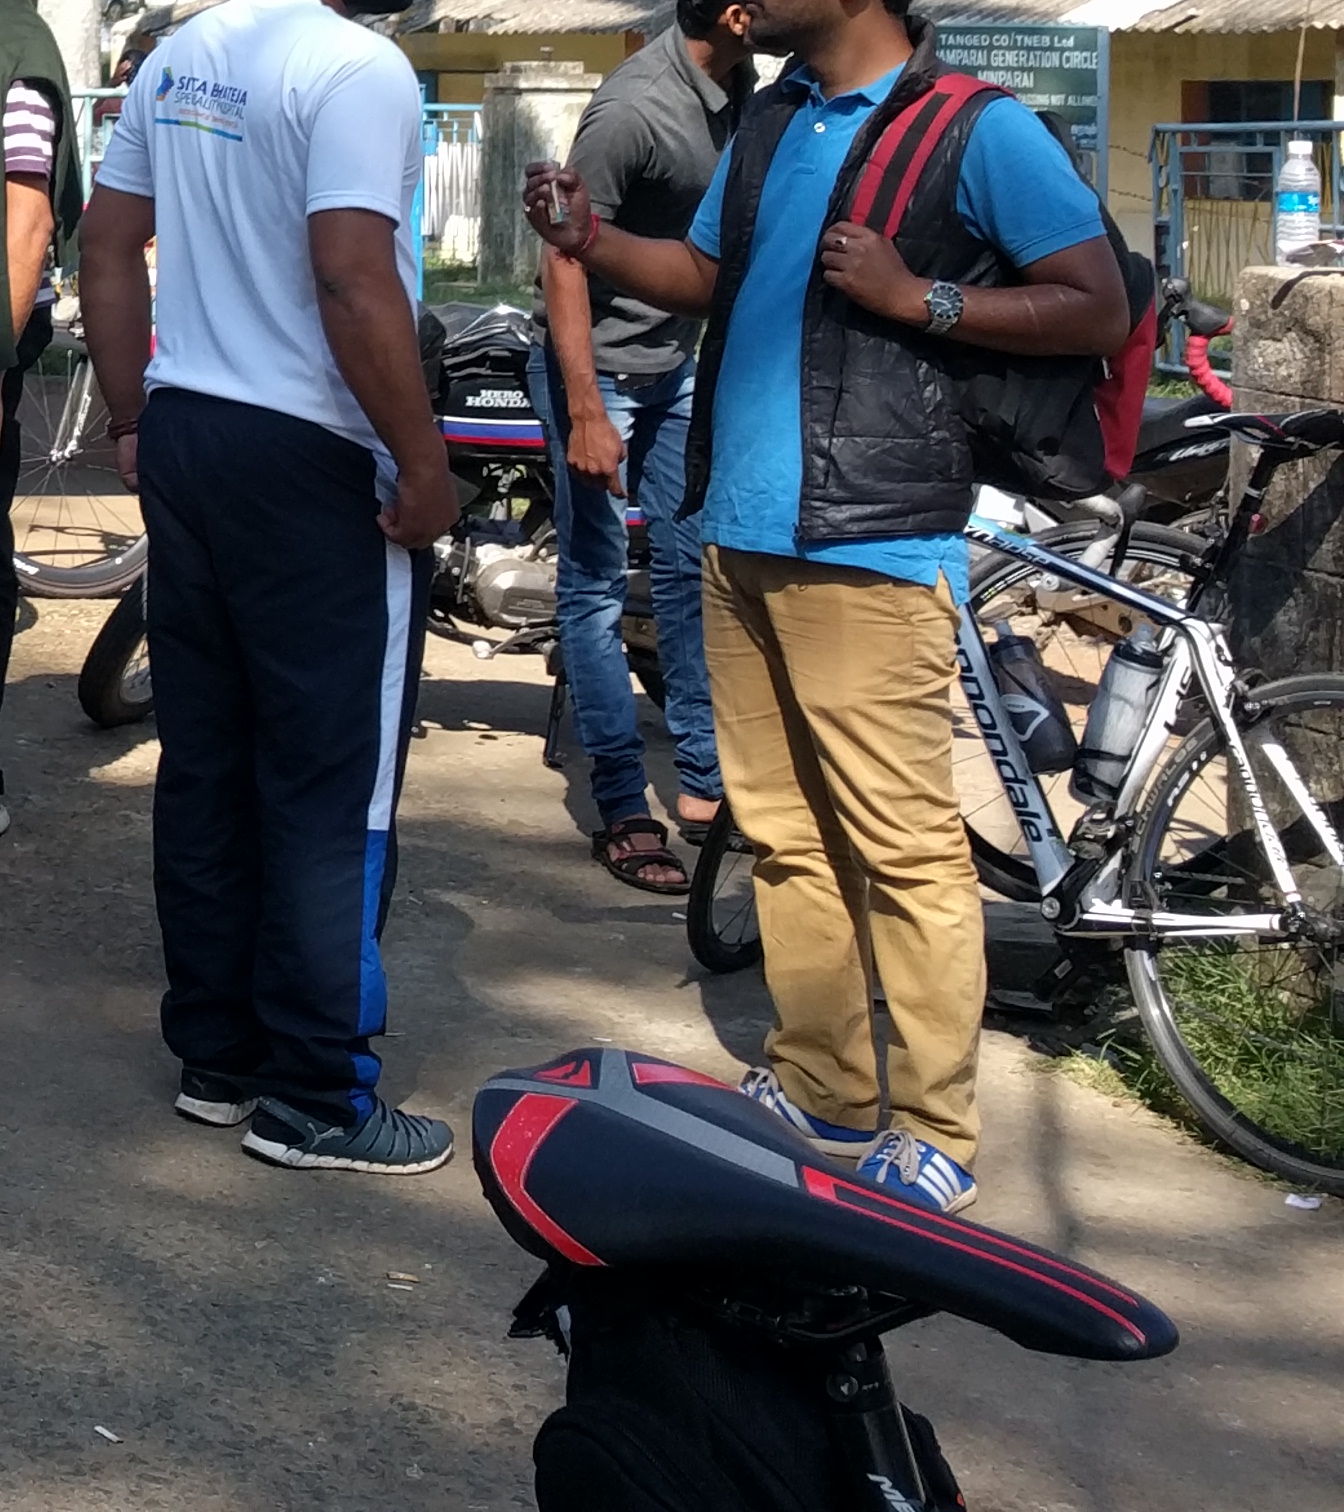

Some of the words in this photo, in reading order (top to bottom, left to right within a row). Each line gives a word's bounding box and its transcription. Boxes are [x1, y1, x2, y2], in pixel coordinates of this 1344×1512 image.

[936, 49, 987, 66] AMPARAI
[990, 50, 1060, 68] GENERATION
[1062, 51, 1098, 69] CIRCLE
[177, 76, 208, 95] SITA
[465, 396, 531, 408] HONDA
[480, 389, 524, 399] HERO
[866, 1473, 918, 1512] ME
